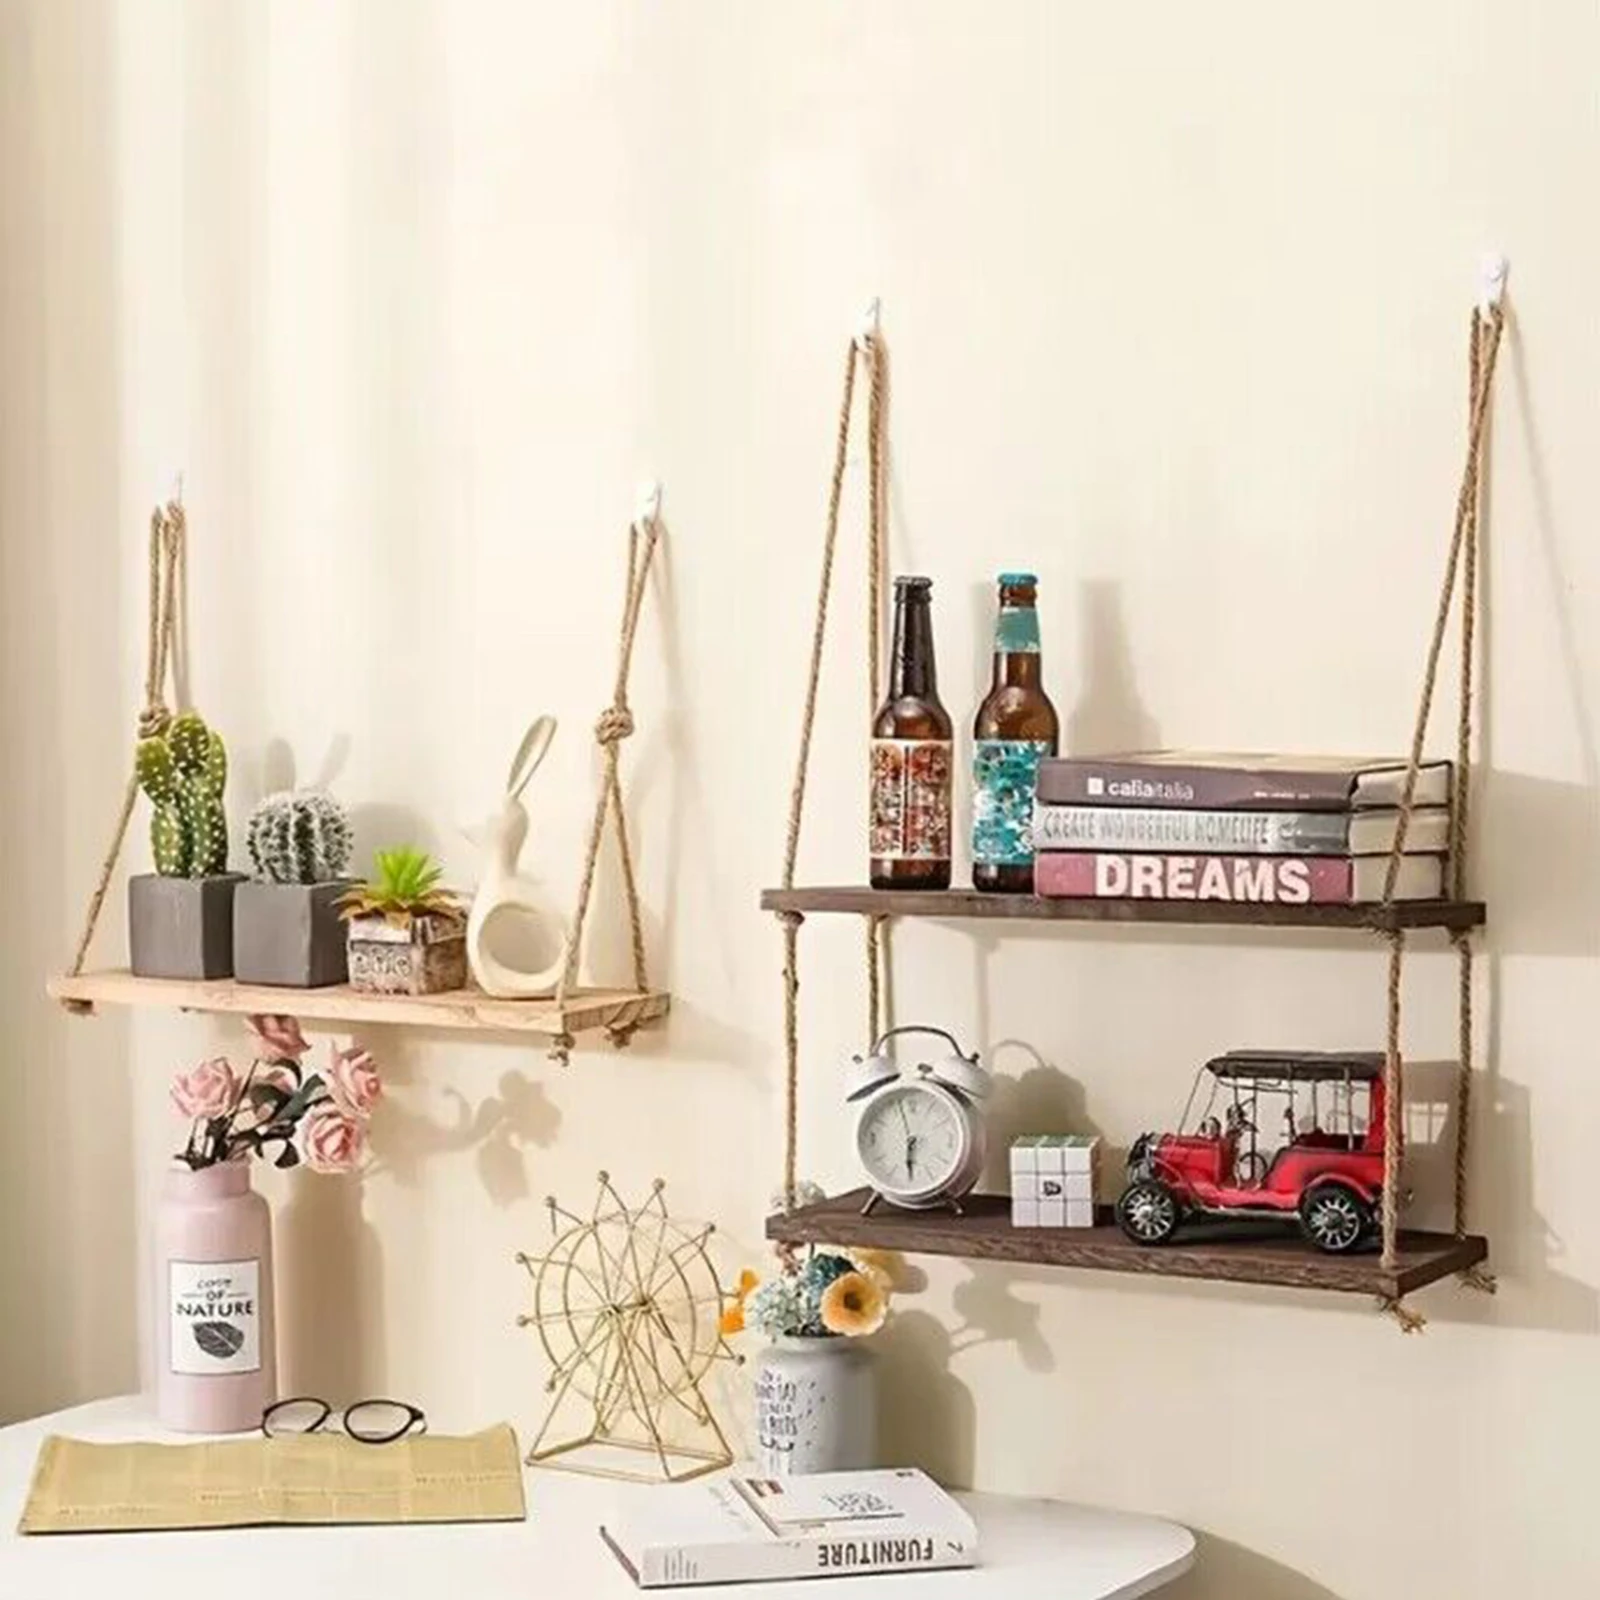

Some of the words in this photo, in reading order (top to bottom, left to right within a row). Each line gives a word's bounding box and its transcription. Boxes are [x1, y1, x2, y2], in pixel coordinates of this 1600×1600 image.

[1096, 854, 1310, 904] DREAMS
[206, 1289, 226, 1302] OF
[176, 1300, 254, 1318] NATURE
[818, 1538, 934, 1567] FURNITURE
